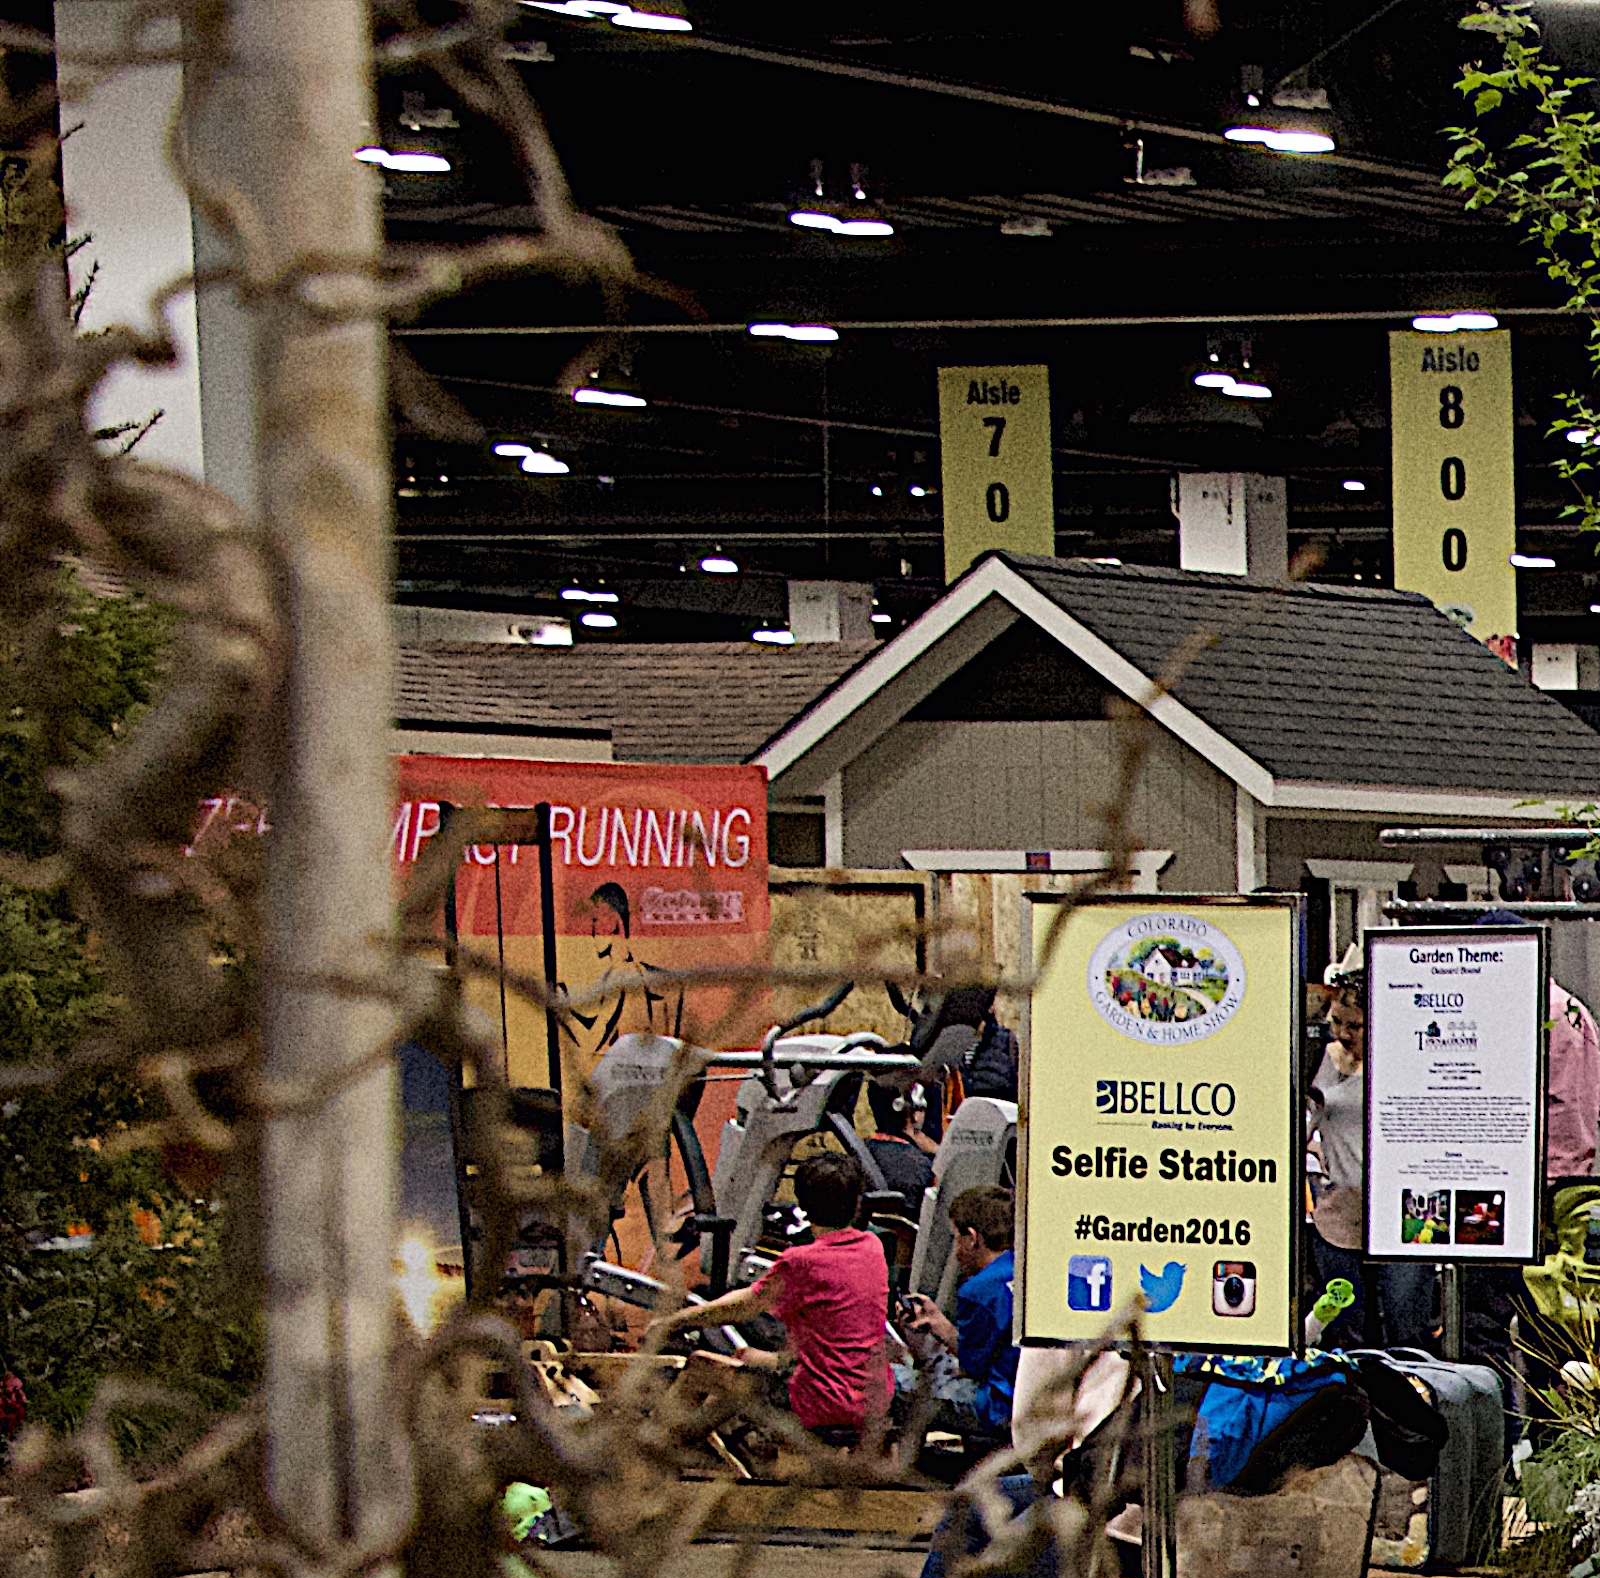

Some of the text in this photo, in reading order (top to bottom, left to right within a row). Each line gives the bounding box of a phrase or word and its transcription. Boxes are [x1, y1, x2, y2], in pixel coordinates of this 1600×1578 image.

[1421, 347, 1480, 373] Aisle
[967, 379, 1021, 405] Aisle
[550, 805, 752, 869] RUNNING
[1128, 917, 1208, 938] COLORADO
[1409, 947, 1503, 964] Garden Theme:
[1420, 993, 1464, 1008] BELLCO
[1095, 991, 1240, 1042] GARDEN & HOME SHOW
[1120, 1080, 1236, 1117] BELLCO
[1051, 1145, 1277, 1183] Selfie Station
[1074, 1214, 1251, 1246] #Garden2016
